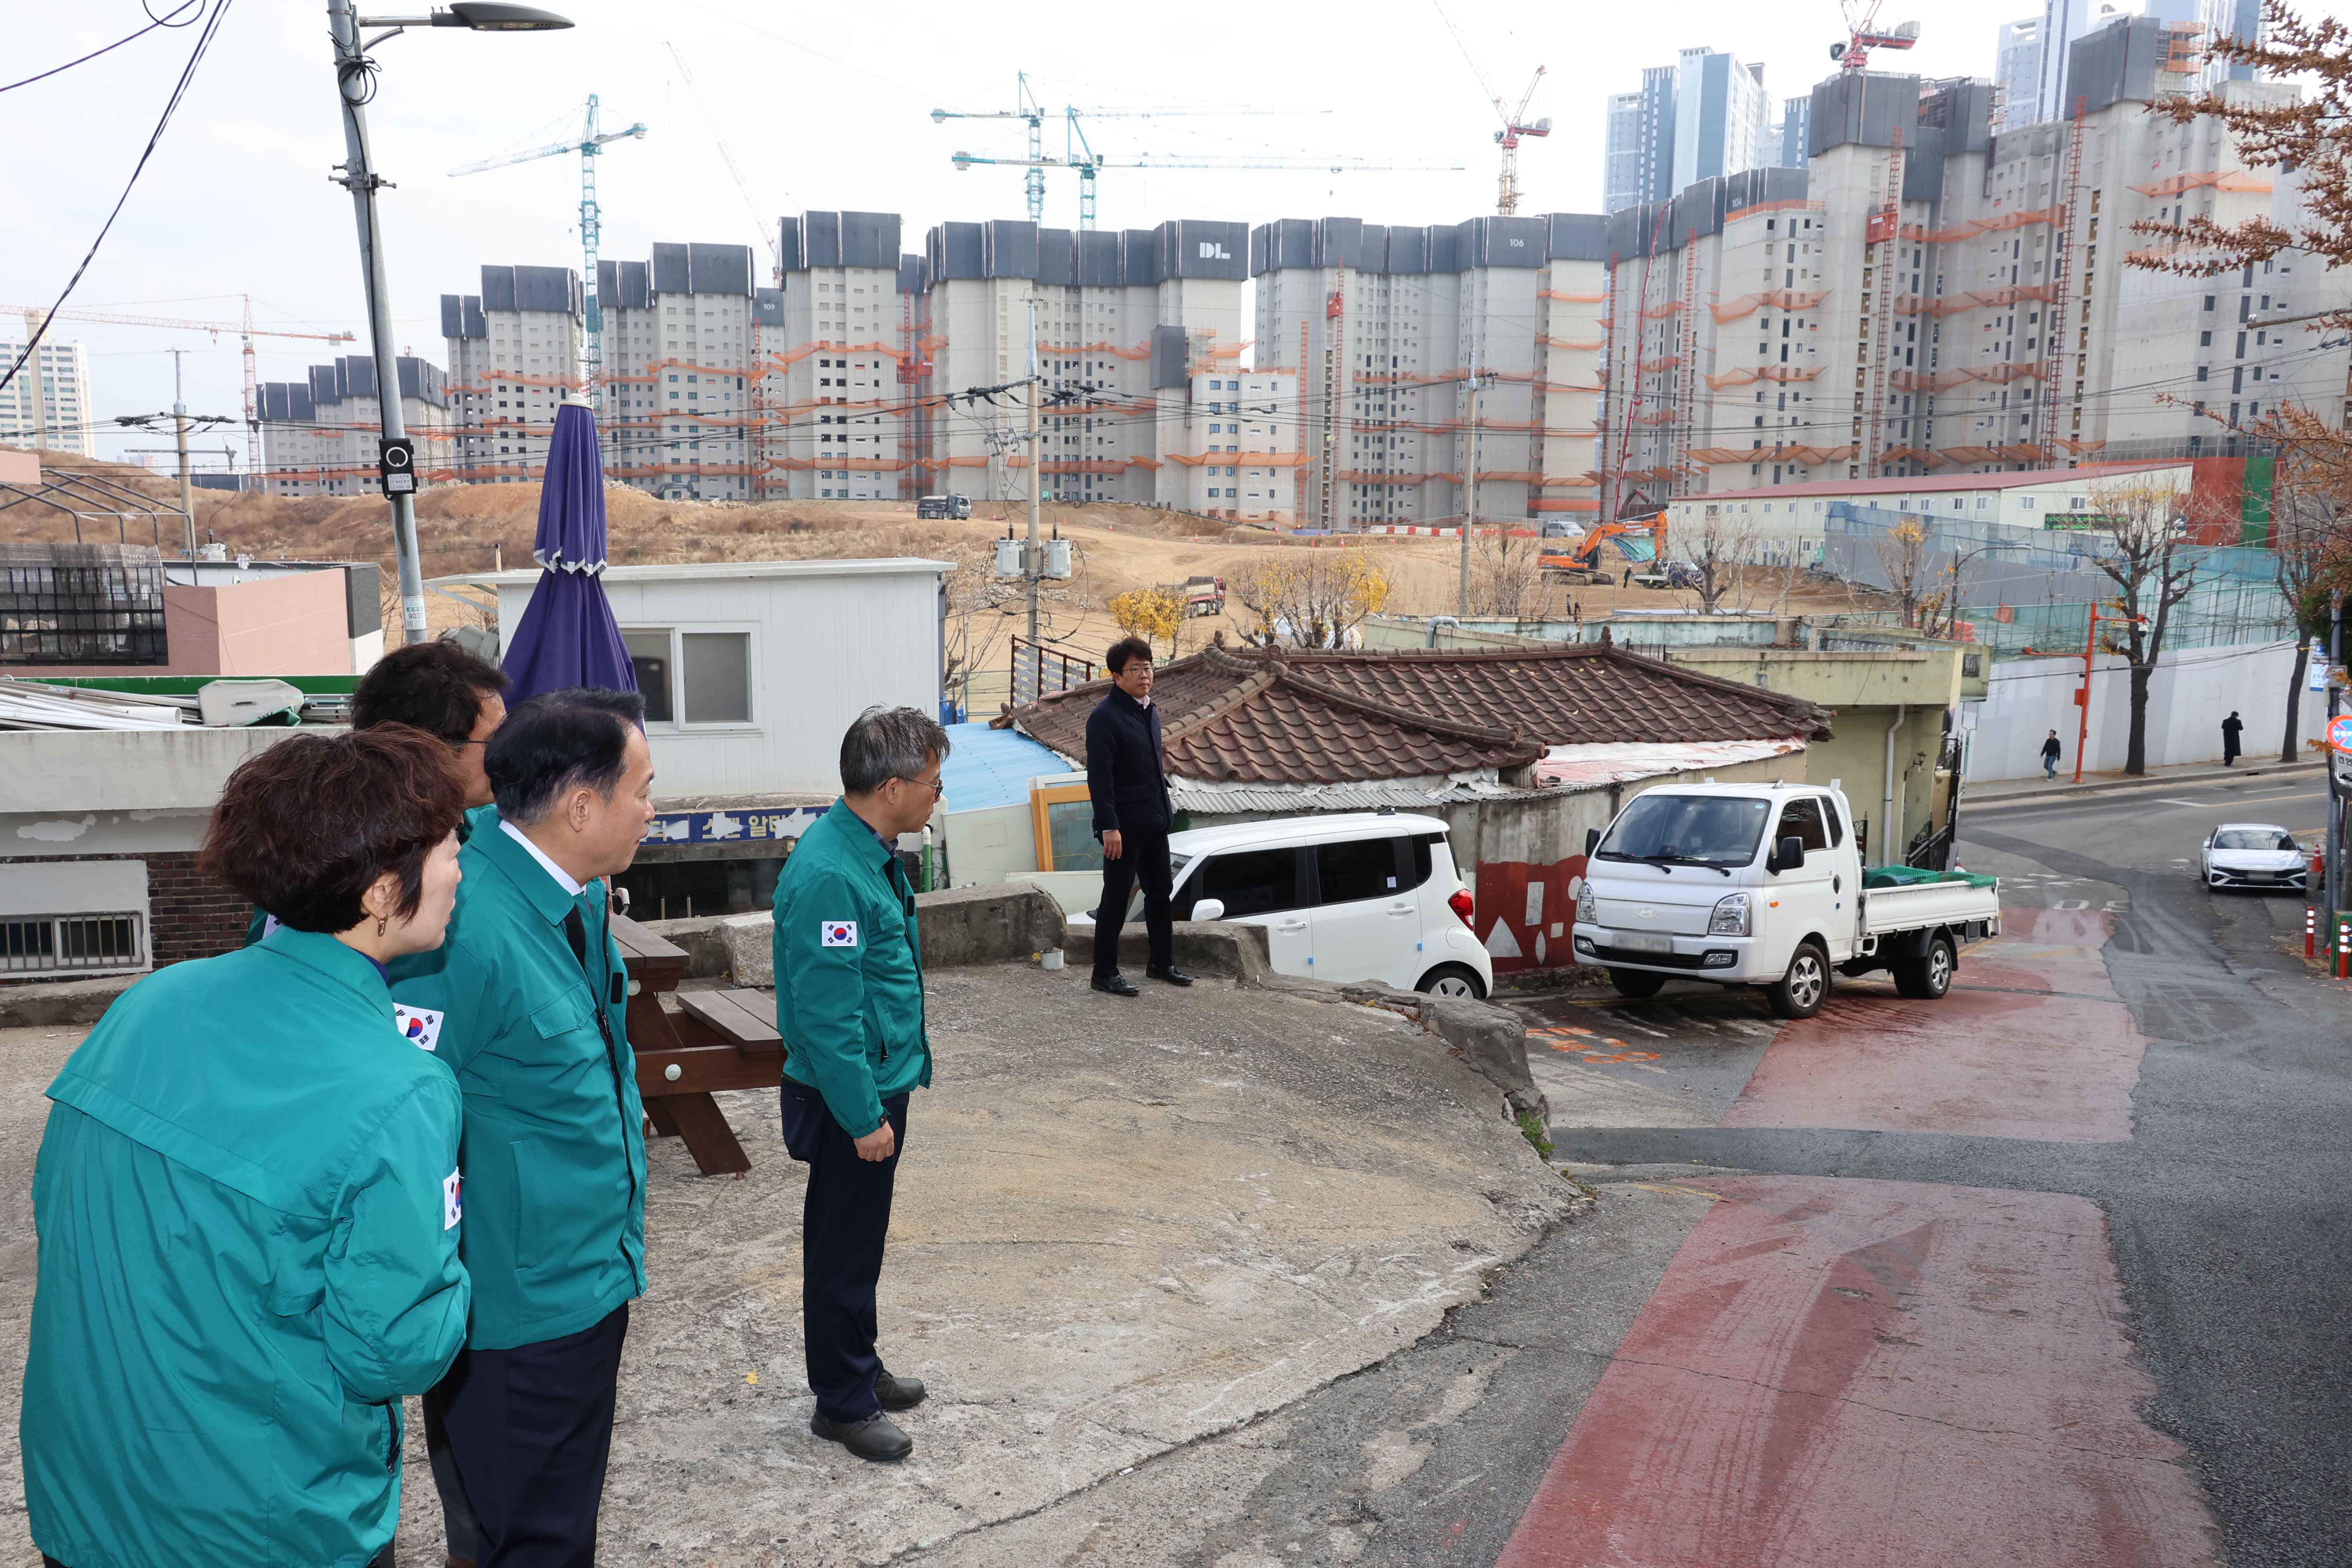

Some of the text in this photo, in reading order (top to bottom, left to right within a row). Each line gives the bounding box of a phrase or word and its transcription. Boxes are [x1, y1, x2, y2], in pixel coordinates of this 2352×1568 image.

[1732, 197, 1742, 208] 104
[1510, 239, 1524, 247] 106
[1199, 242, 1230, 259] DL
